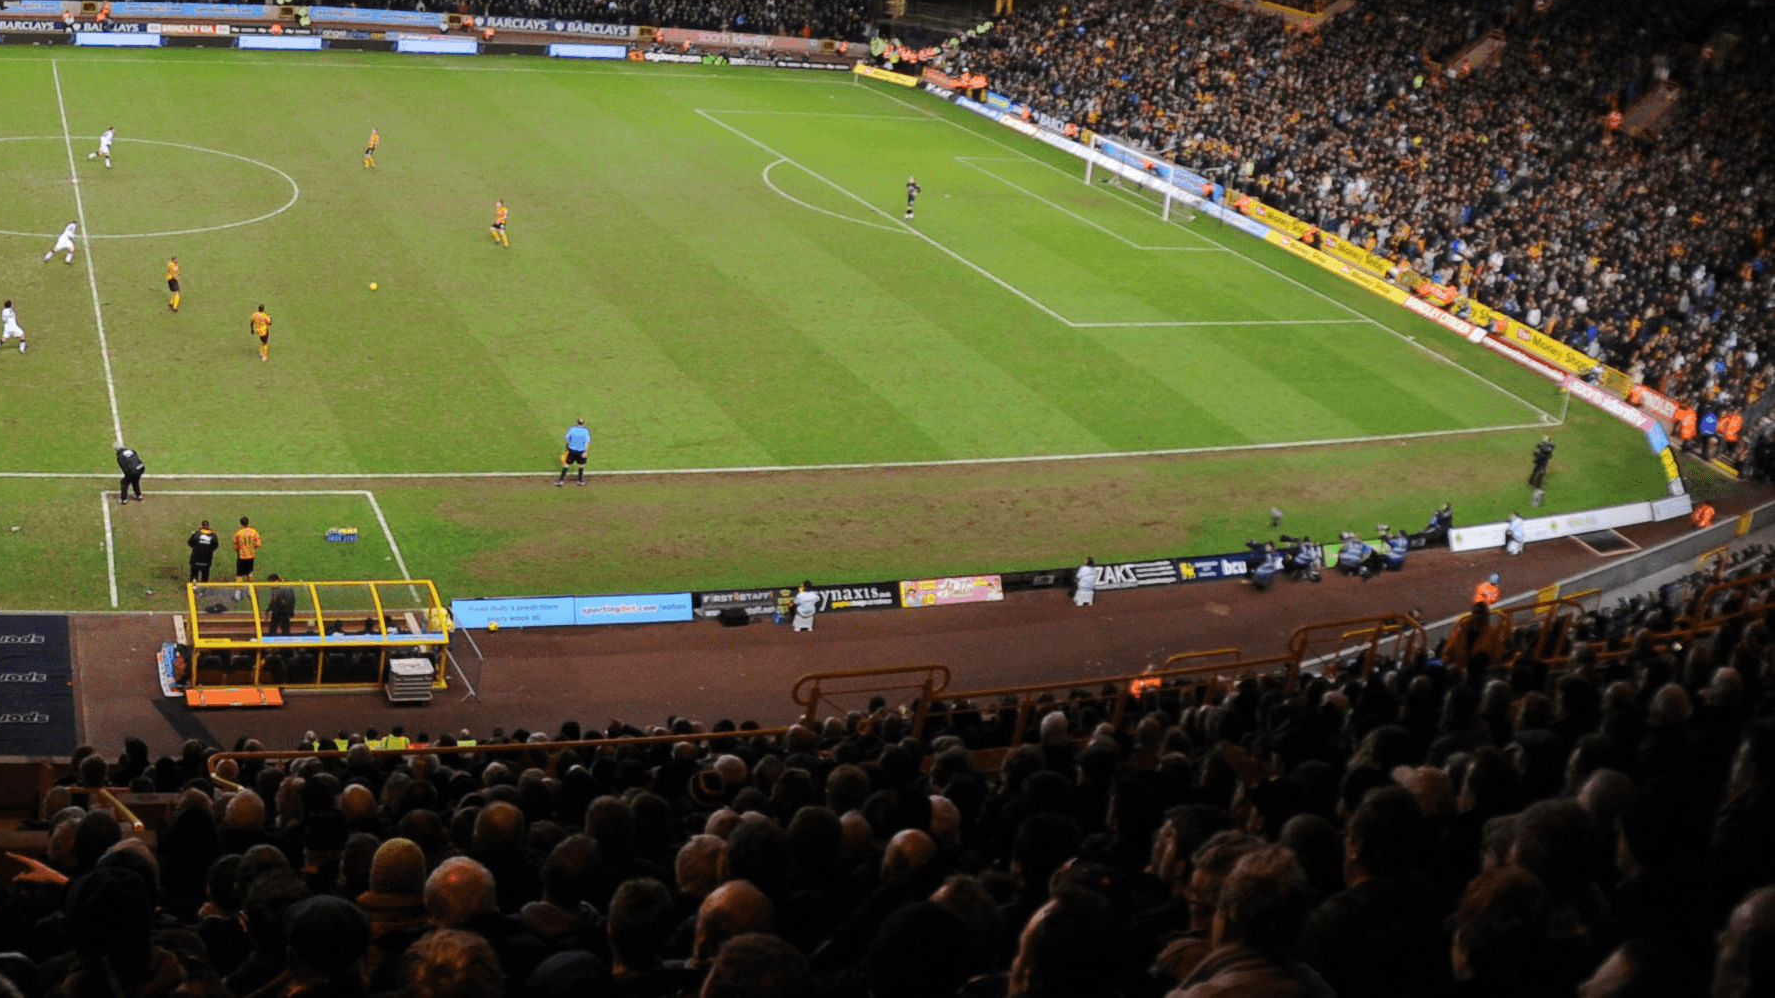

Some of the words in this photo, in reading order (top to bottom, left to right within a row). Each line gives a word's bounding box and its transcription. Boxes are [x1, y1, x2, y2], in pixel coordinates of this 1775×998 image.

[0, 21, 54, 31] BARCLAYS
[487, 17, 548, 31] BARCLAYS
[567, 22, 627, 36] BARCLAYS
[1096, 564, 1138, 585] ZAKS
[581, 603, 658, 615] sportingbet.com
